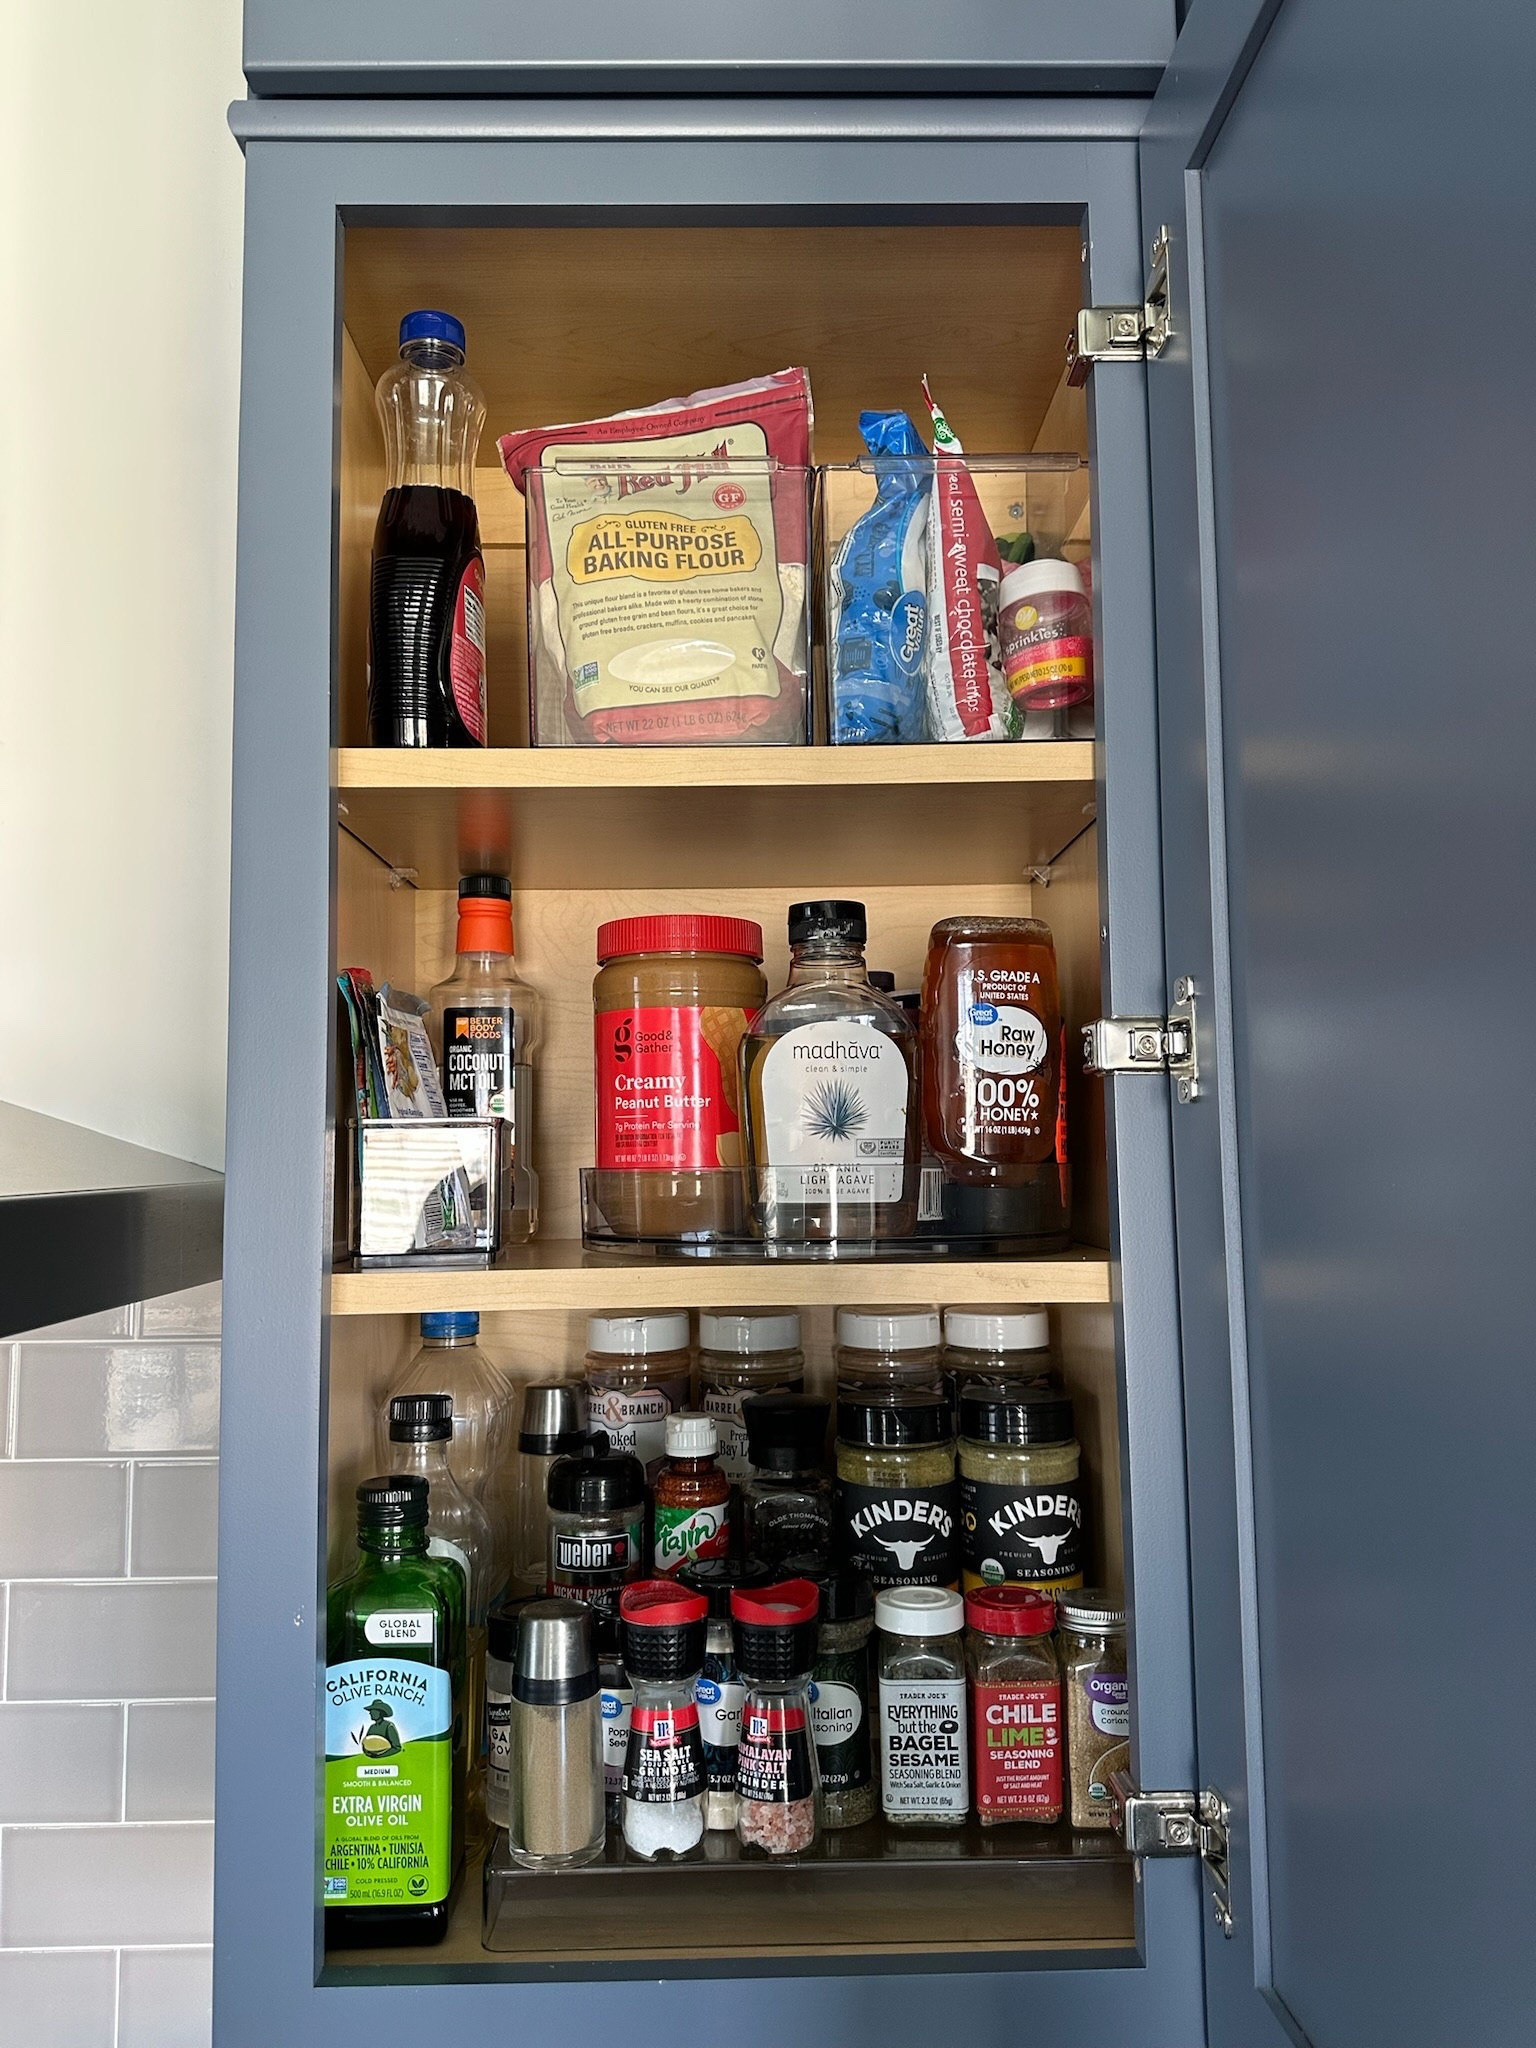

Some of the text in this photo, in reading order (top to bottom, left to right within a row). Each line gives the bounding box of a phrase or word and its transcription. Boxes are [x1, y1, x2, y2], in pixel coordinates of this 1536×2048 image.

[674, 416, 705, 427] Company
[719, 493, 741, 502] GF
[626, 521, 696, 533] GLUTEN FREE
[588, 532, 737, 552] ALL-PURPOSE
[950, 500, 971, 594] semi-sweet
[584, 550, 745, 575] BAKING FLOUR
[900, 604, 919, 662] Great
[914, 609, 924, 651] Value
[957, 599, 978, 678] chocolate
[629, 685, 643, 693] YOU
[966, 680, 980, 712] chips
[606, 712, 722, 732] NET WT 22 OZ (1 LB OZ)
[967, 970, 1040, 984] U.S. GRADE A
[1007, 992, 1029, 1000] STATES
[970, 1008, 994, 1016] Great
[1002, 1026, 1035, 1041] Raw
[449, 1045, 472, 1053] ORGANIC
[635, 1043, 674, 1053] Gather
[982, 1040, 1035, 1060] Honey
[449, 1054, 504, 1071] COCONUT
[806, 1065, 829, 1073] clean
[841, 1065, 868, 1074] simple
[449, 1073, 497, 1090] MCT OIL
[615, 1074, 686, 1092] Creamy
[615, 1095, 711, 1110] Peanut Butter
[980, 1108, 1030, 1121] HONEY
[615, 1123, 622, 1132] 7g
[624, 1121, 649, 1130] Protein
[652, 1121, 665, 1129] Per
[1018, 1126, 1030, 1136] 454g
[838, 1175, 874, 1184] AGAVE
[622, 1403, 663, 1415] BRANCH
[706, 1402, 737, 1414] BARREL
[720, 1440, 736, 1460] Bay
[769, 1513, 829, 1527] OLDE THOMPSON
[851, 1500, 952, 1538] KINDER'S
[560, 1539, 612, 1567] weber
[1017, 1564, 1075, 1577] SEASONING
[874, 1575, 937, 1585] SEASONING
[554, 1585, 583, 1599] KICK'N
[380, 1620, 421, 1628] GLOBAL
[385, 1629, 417, 1638] BLEND
[326, 1670, 427, 1692] CALIFORNIA
[1091, 1680, 1127, 1693] Organi
[332, 1684, 424, 1706] OLIVE RANCH
[814, 1708, 852, 1720] Italian
[888, 1705, 958, 1720] EVERYTHING
[986, 1704, 1056, 1724] CHILE
[899, 1720, 936, 1733] but the
[890, 1736, 958, 1750] BAGEL
[987, 1728, 1044, 1747] LIME
[640, 1745, 691, 1761] SEA SALT
[890, 1754, 959, 1766] SESAME
[990, 1749, 1053, 1759] SEASONING
[639, 1763, 694, 1776] GRINDER
[738, 1756, 787, 1773] PINK SALT
[1005, 1760, 1040, 1769] BLEND
[738, 1773, 786, 1789] GRINDER
[830, 1774, 848, 1784] (27g)
[890, 1769, 961, 1779] SEASONING BLEND
[333, 1795, 421, 1813] EXTRA VIRGIN
[346, 1815, 408, 1826] OLIVE OIL
[331, 1842, 424, 1856] ARGENTINA TUNISIA
[326, 1856, 428, 1870] CHILE 10% CALIFORNIA
[350, 1890, 361, 1898] 500
